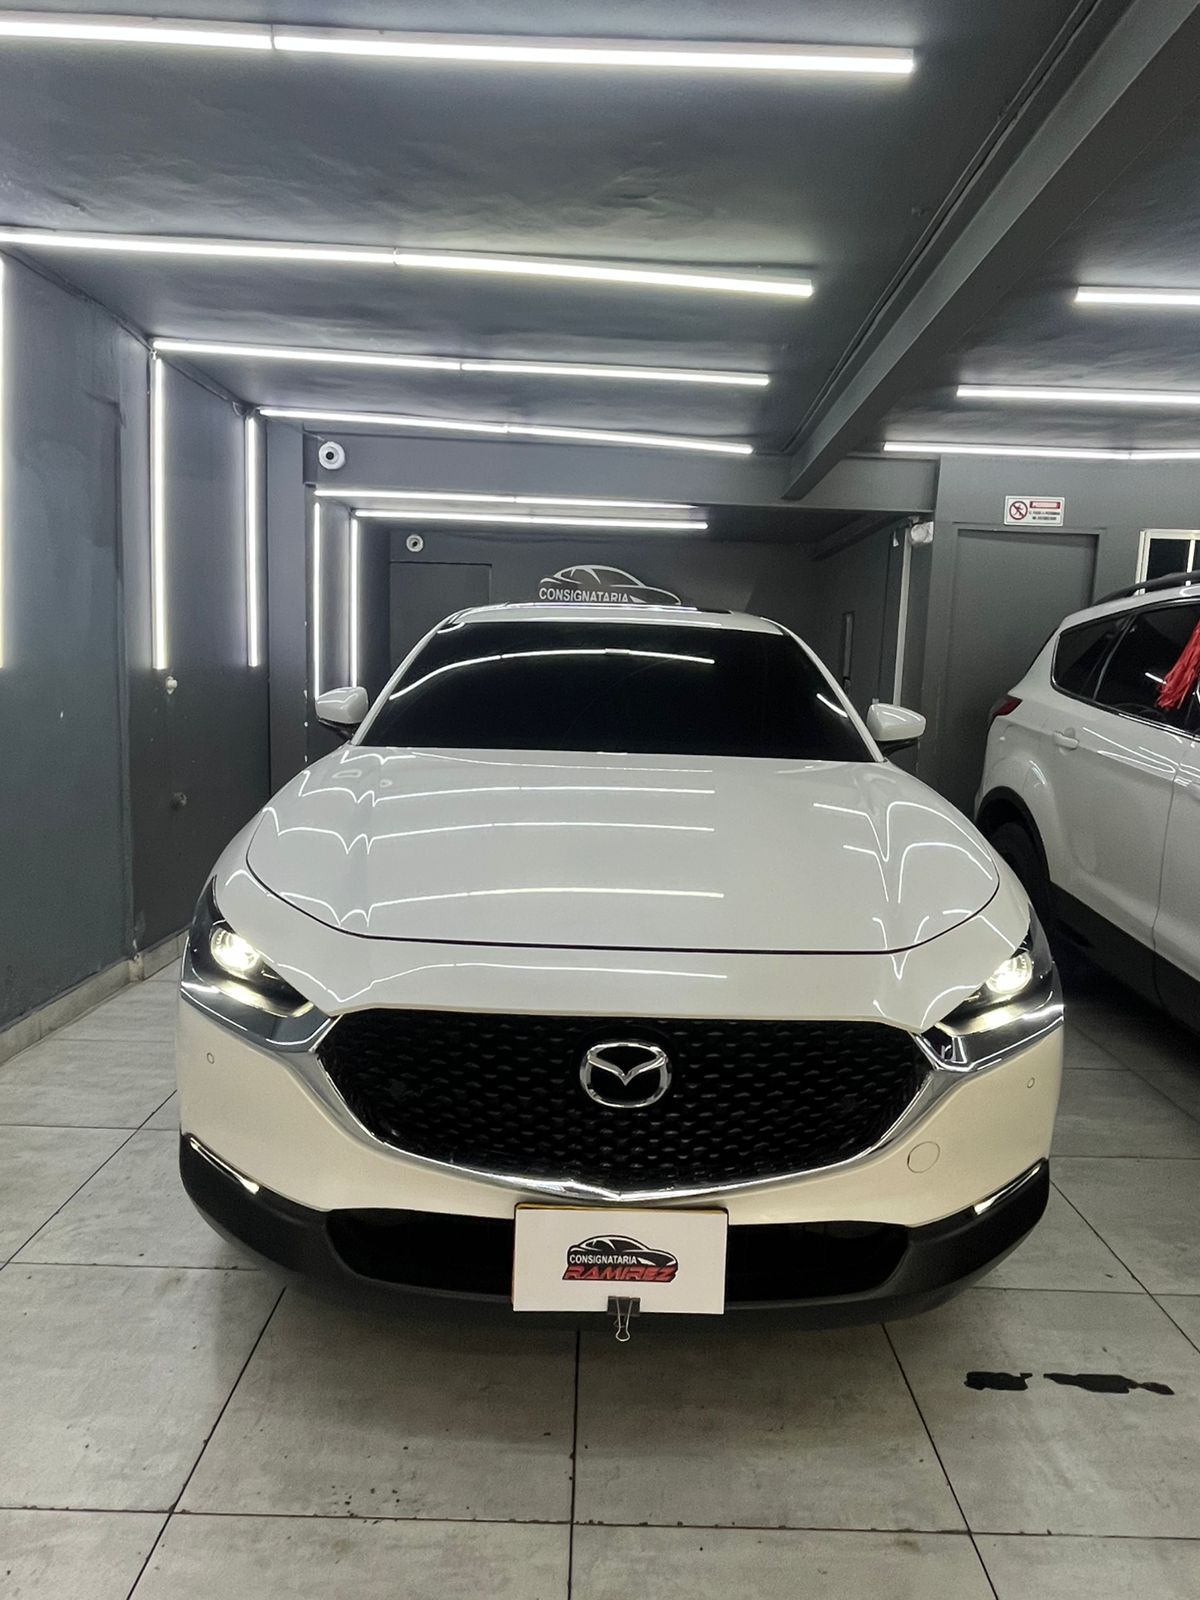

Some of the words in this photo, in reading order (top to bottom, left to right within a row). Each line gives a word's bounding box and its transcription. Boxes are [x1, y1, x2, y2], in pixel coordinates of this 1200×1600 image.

[539, 587, 629, 602] CONSIGNATARIA
[569, 1254, 638, 1265] CONSIGNATARIA
[564, 1266, 677, 1281] RAMIREZ
